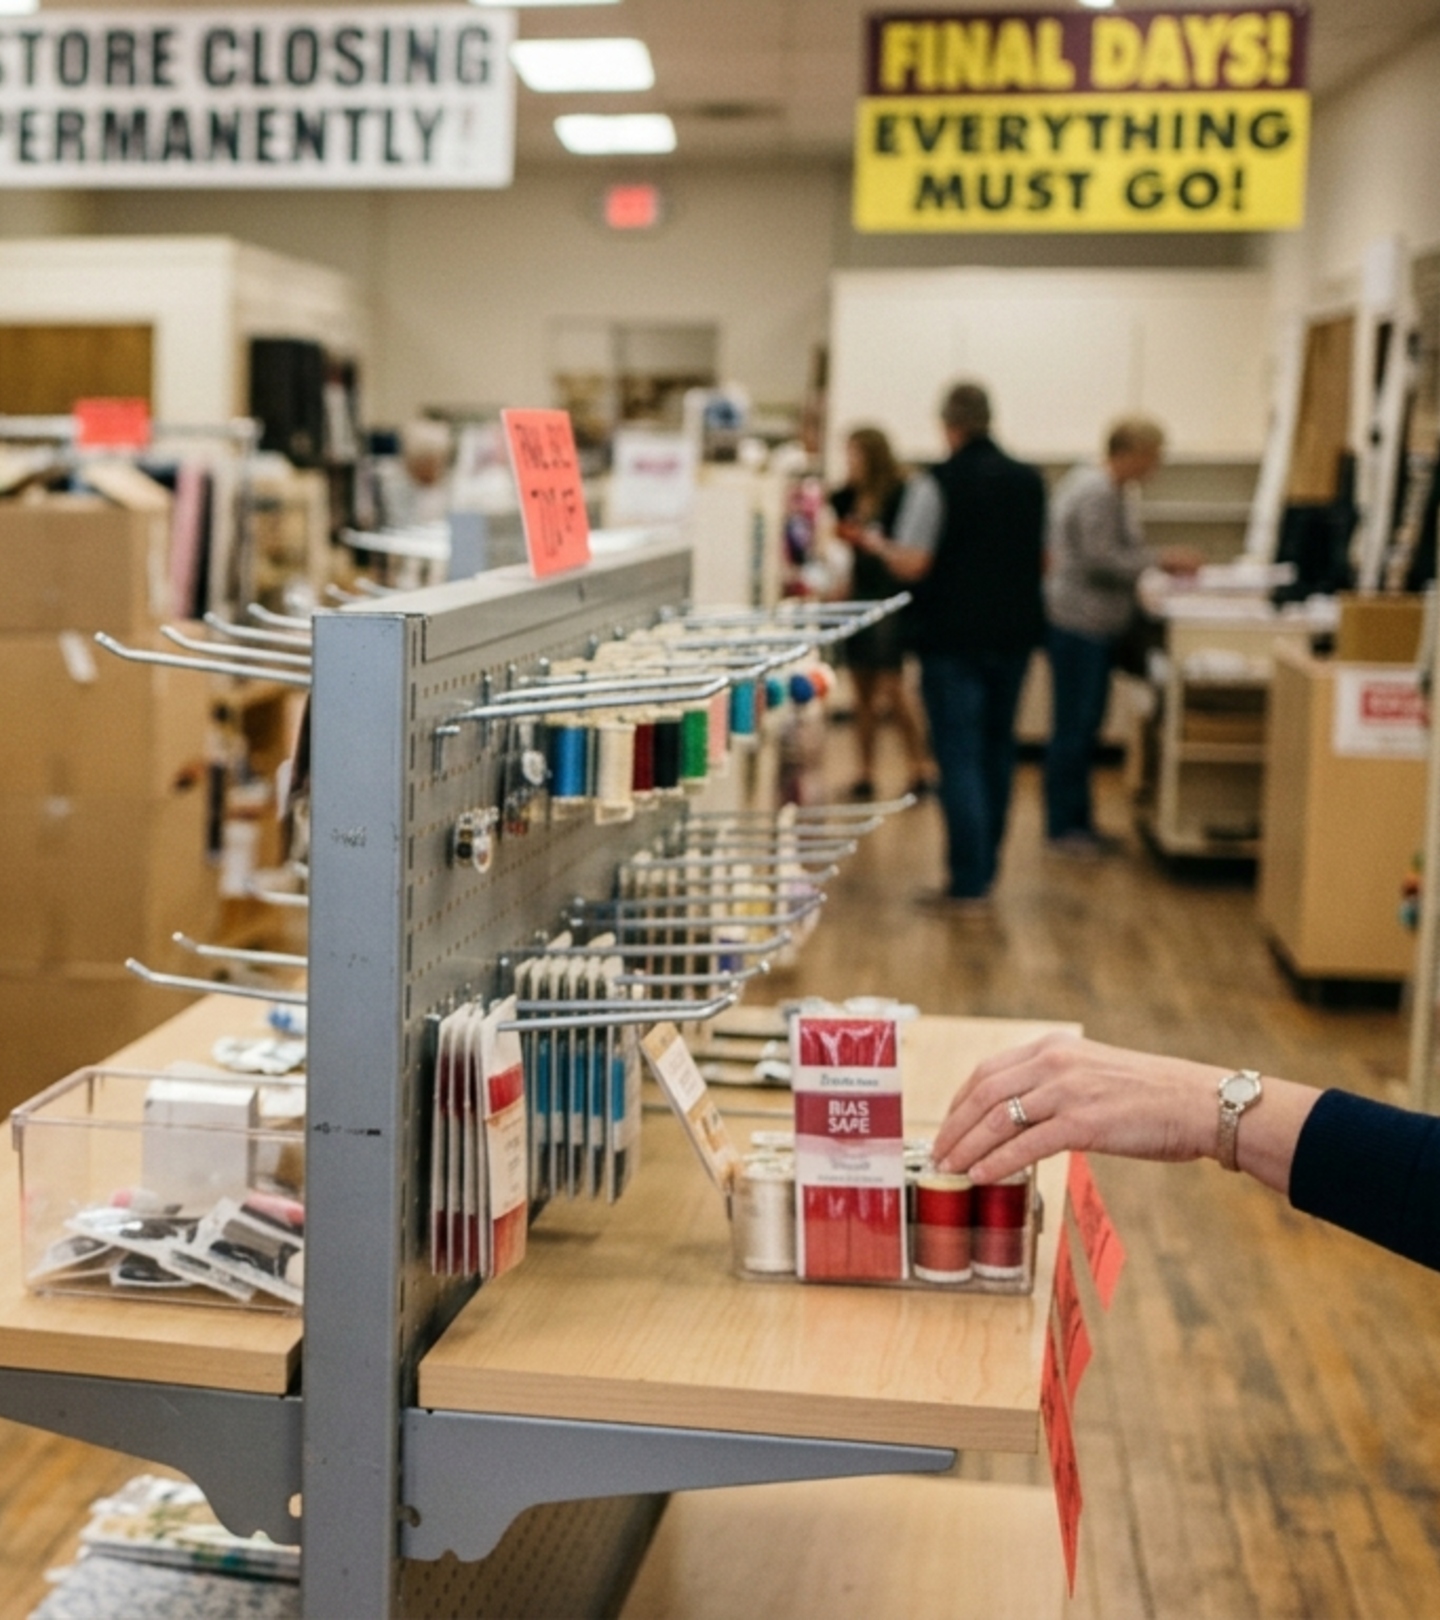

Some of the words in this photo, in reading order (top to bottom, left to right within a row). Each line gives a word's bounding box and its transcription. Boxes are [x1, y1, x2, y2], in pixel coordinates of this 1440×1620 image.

[202, 26, 489, 87] CLOSING
[878, 17, 1077, 92] FINAL
[1089, 10, 1293, 89] DAYS!
[873, 109, 1293, 155] EVERYTHING
[914, 171, 1092, 212] MUST
[1124, 167, 1246, 212] GO!
